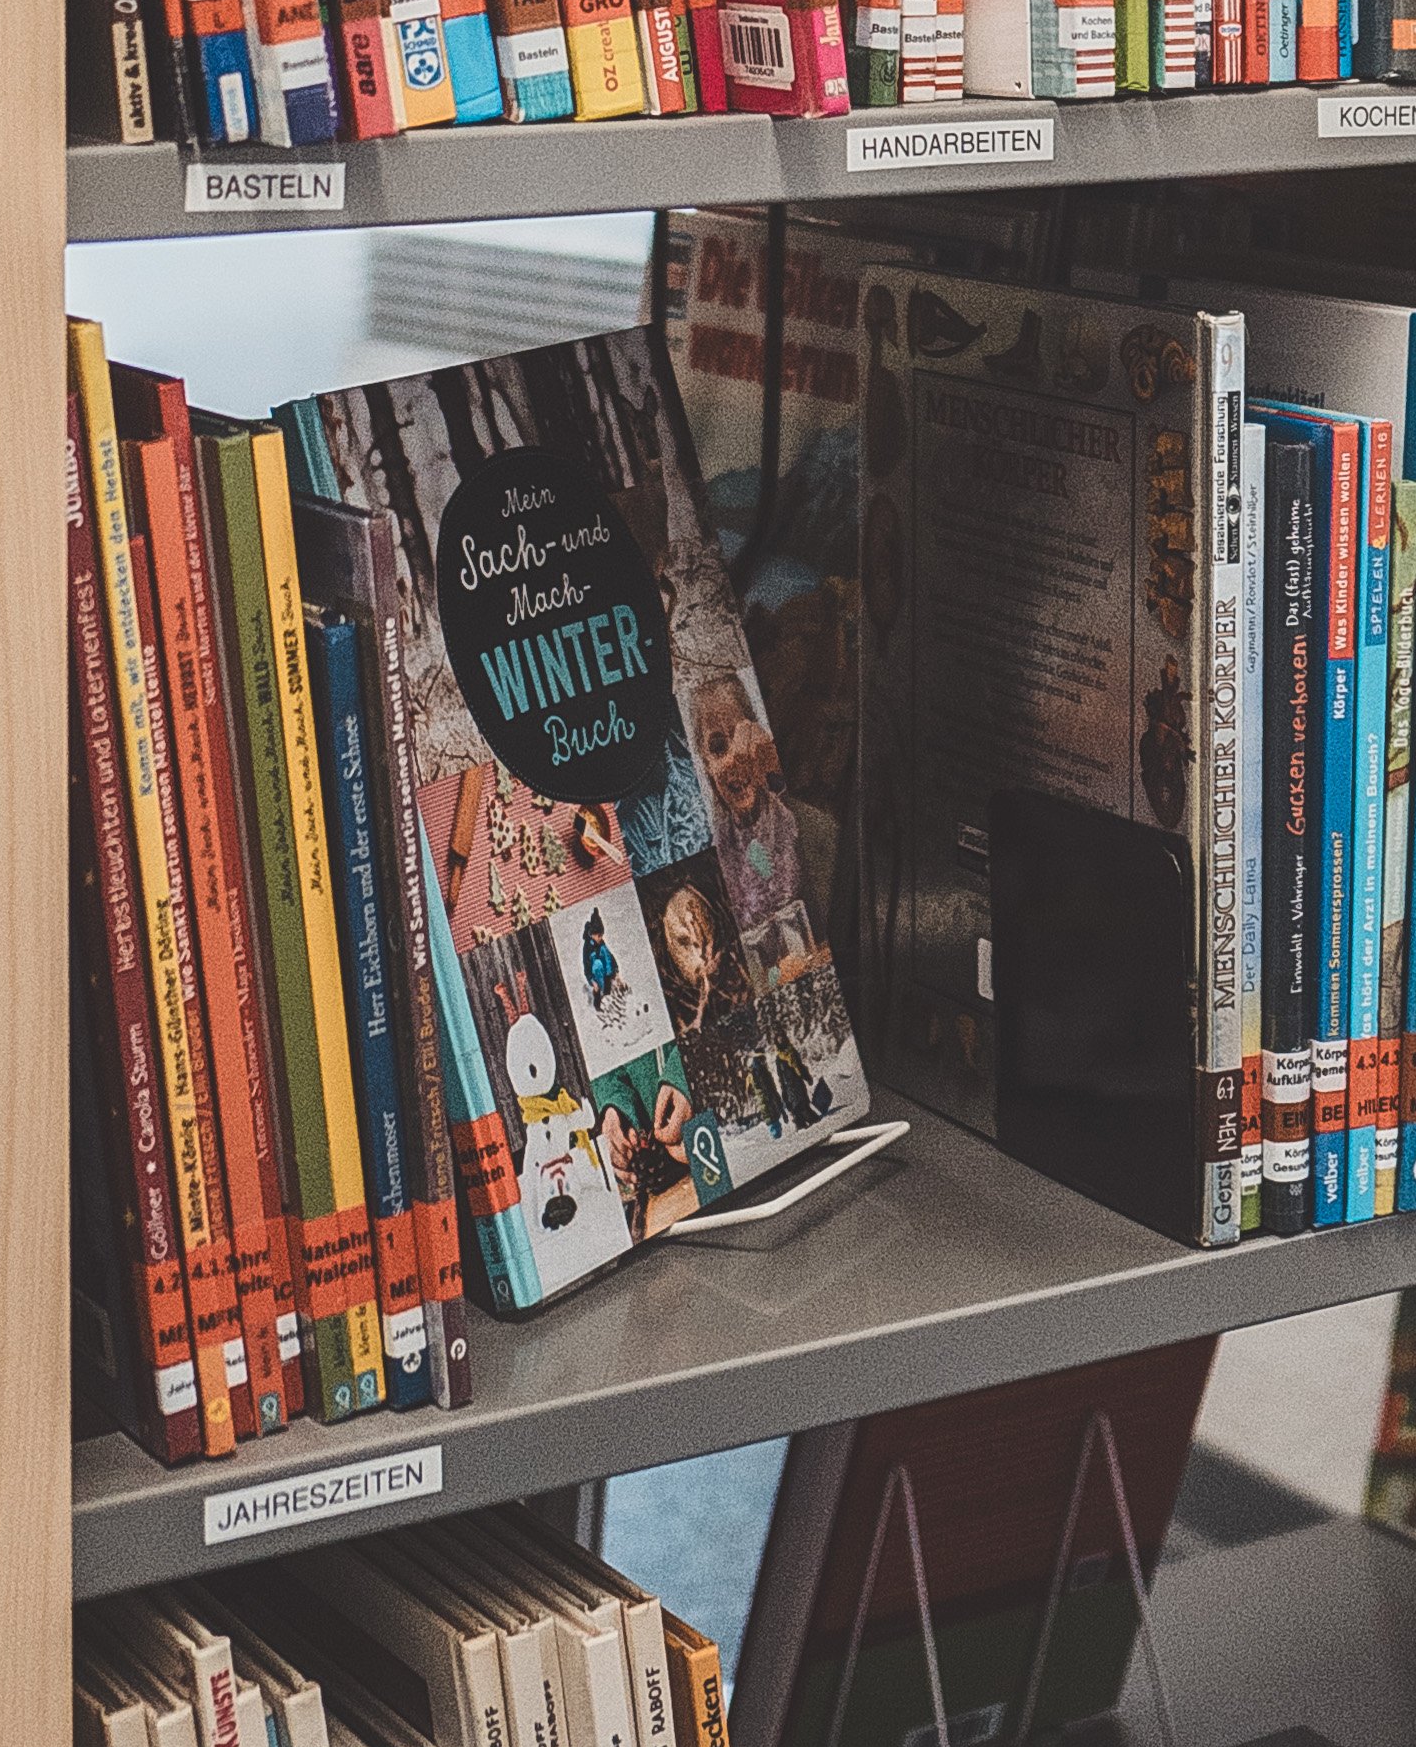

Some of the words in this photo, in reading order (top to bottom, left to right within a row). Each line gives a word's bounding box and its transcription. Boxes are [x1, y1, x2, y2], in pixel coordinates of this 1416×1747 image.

[518, 45, 558, 60] Basteln
[861, 129, 1042, 159] HANDARBEITEN
[206, 173, 332, 200] BASTELN
[502, 485, 556, 518] Mein
[459, 533, 558, 593] Sach-
[561, 522, 610, 553] und
[1336, 507, 1349, 556] wissen
[505, 582, 593, 628] Mach-
[1335, 560, 1348, 613] Kinder
[1334, 618, 1346, 650] Was
[481, 603, 653, 722] WINTER-
[1332, 667, 1346, 720] Körper
[543, 716, 636, 767] Buch
[1214, 743, 1236, 1010] MENSCHLICHER
[136, 1093, 155, 1152] Carola
[1327, 1151, 1339, 1204] velber
[217, 1461, 424, 1531] JAHRESZEITEN
[646, 1665, 666, 1737] RABOFF
